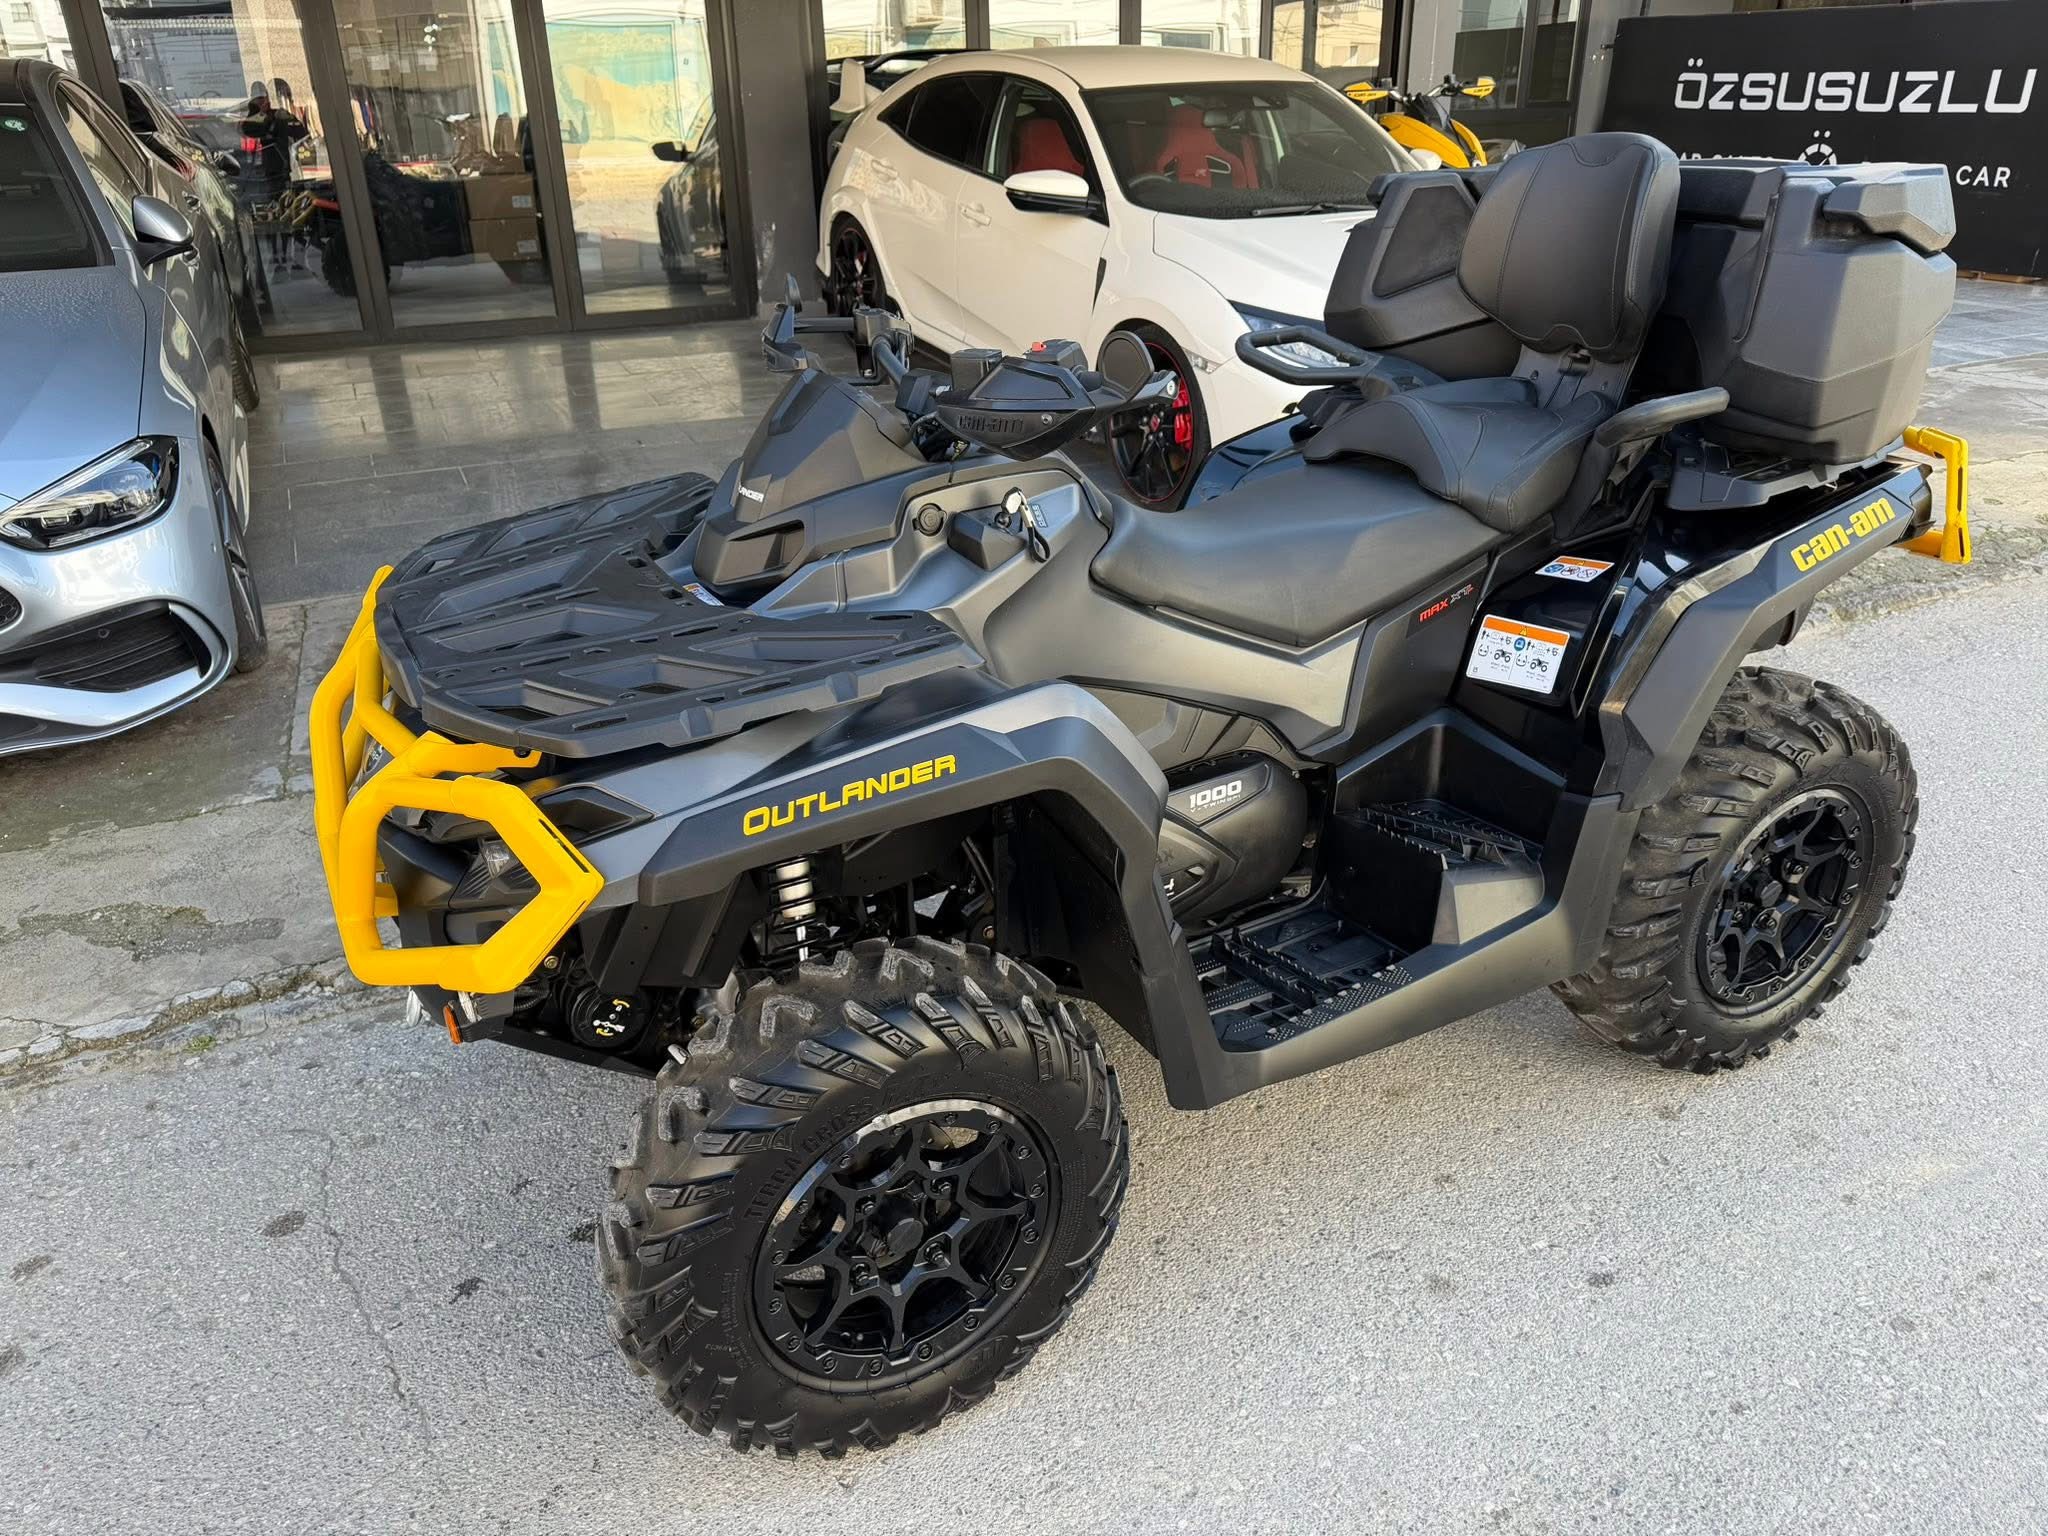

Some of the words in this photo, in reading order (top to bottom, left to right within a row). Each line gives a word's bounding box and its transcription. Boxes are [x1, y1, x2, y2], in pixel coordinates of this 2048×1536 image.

[1674, 58, 2038, 114] ÖZSUSUZLU
[1955, 165, 2011, 189] CAR
[1790, 497, 1896, 572] can-am
[743, 754, 957, 836] OUTLANDER
[1189, 780, 1242, 809] 1000
